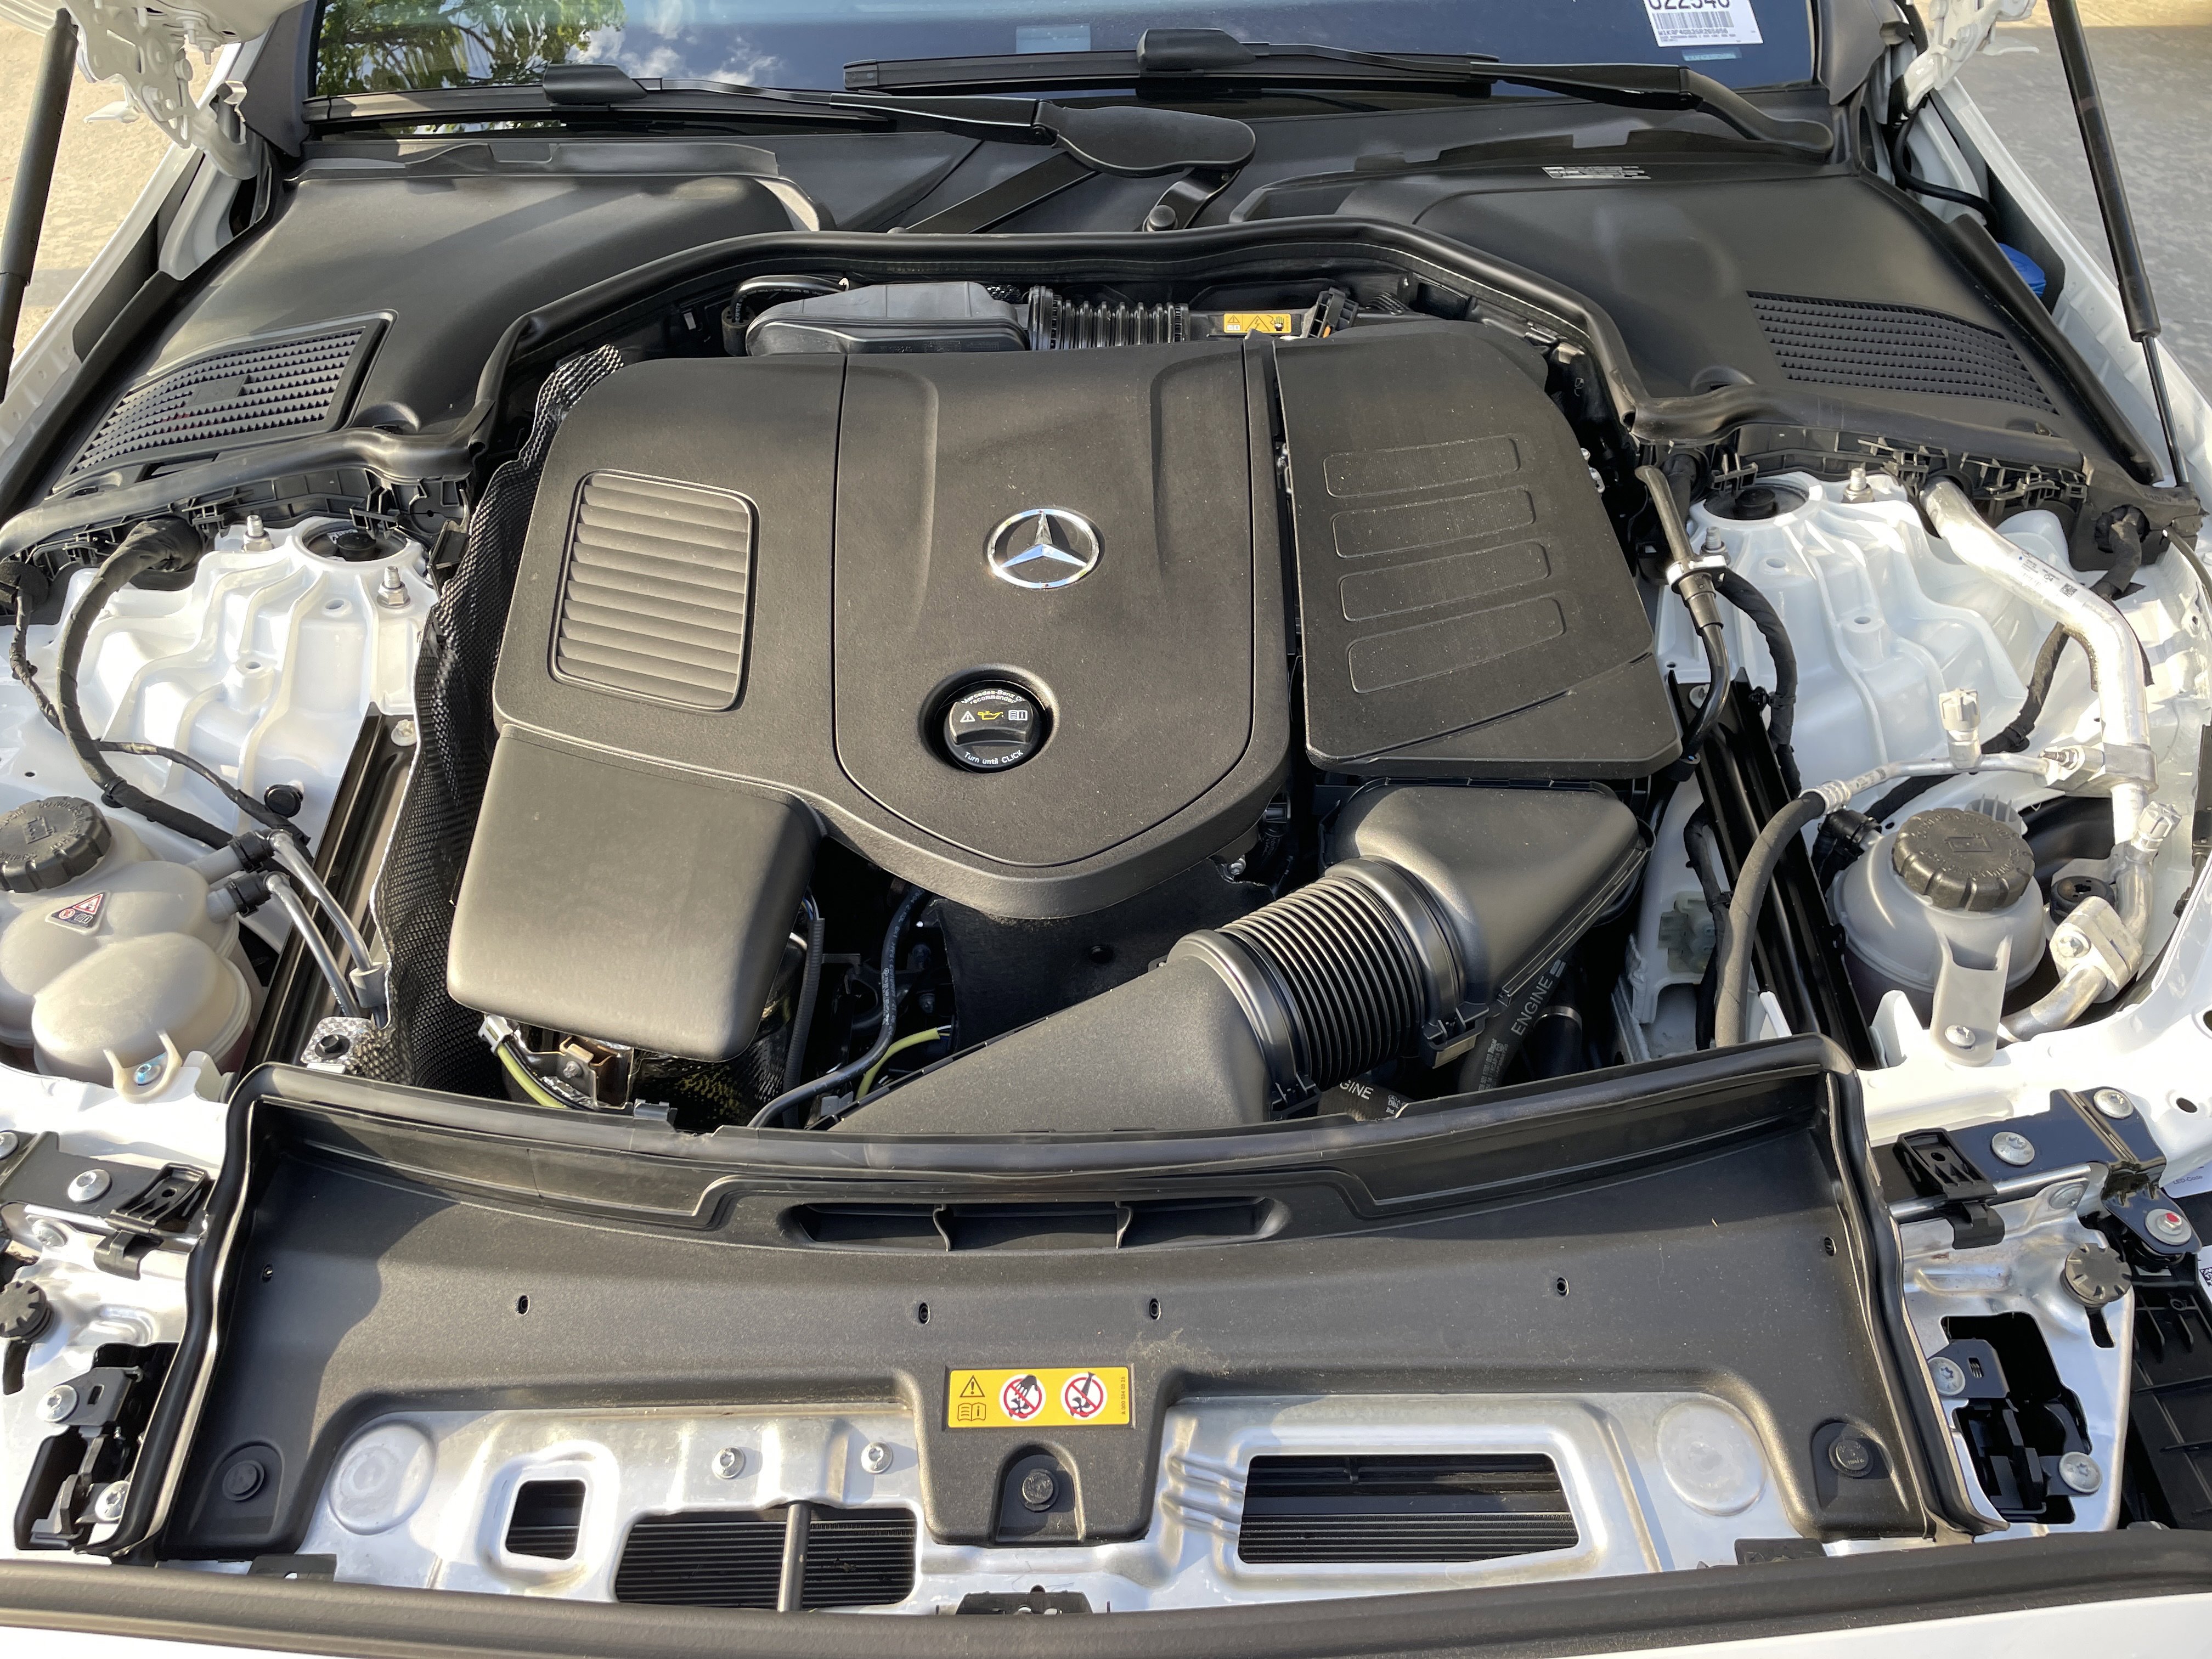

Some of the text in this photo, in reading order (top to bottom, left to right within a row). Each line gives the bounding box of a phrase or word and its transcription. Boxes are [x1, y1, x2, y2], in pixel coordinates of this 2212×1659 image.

[964, 751, 980, 763] Turn
[1001, 749, 1024, 763] CLICK
[1511, 975, 1554, 1036] ENGINE
[1340, 1080, 1374, 1100] GINE
[2173, 1176, 2203, 1184] LED-Code
